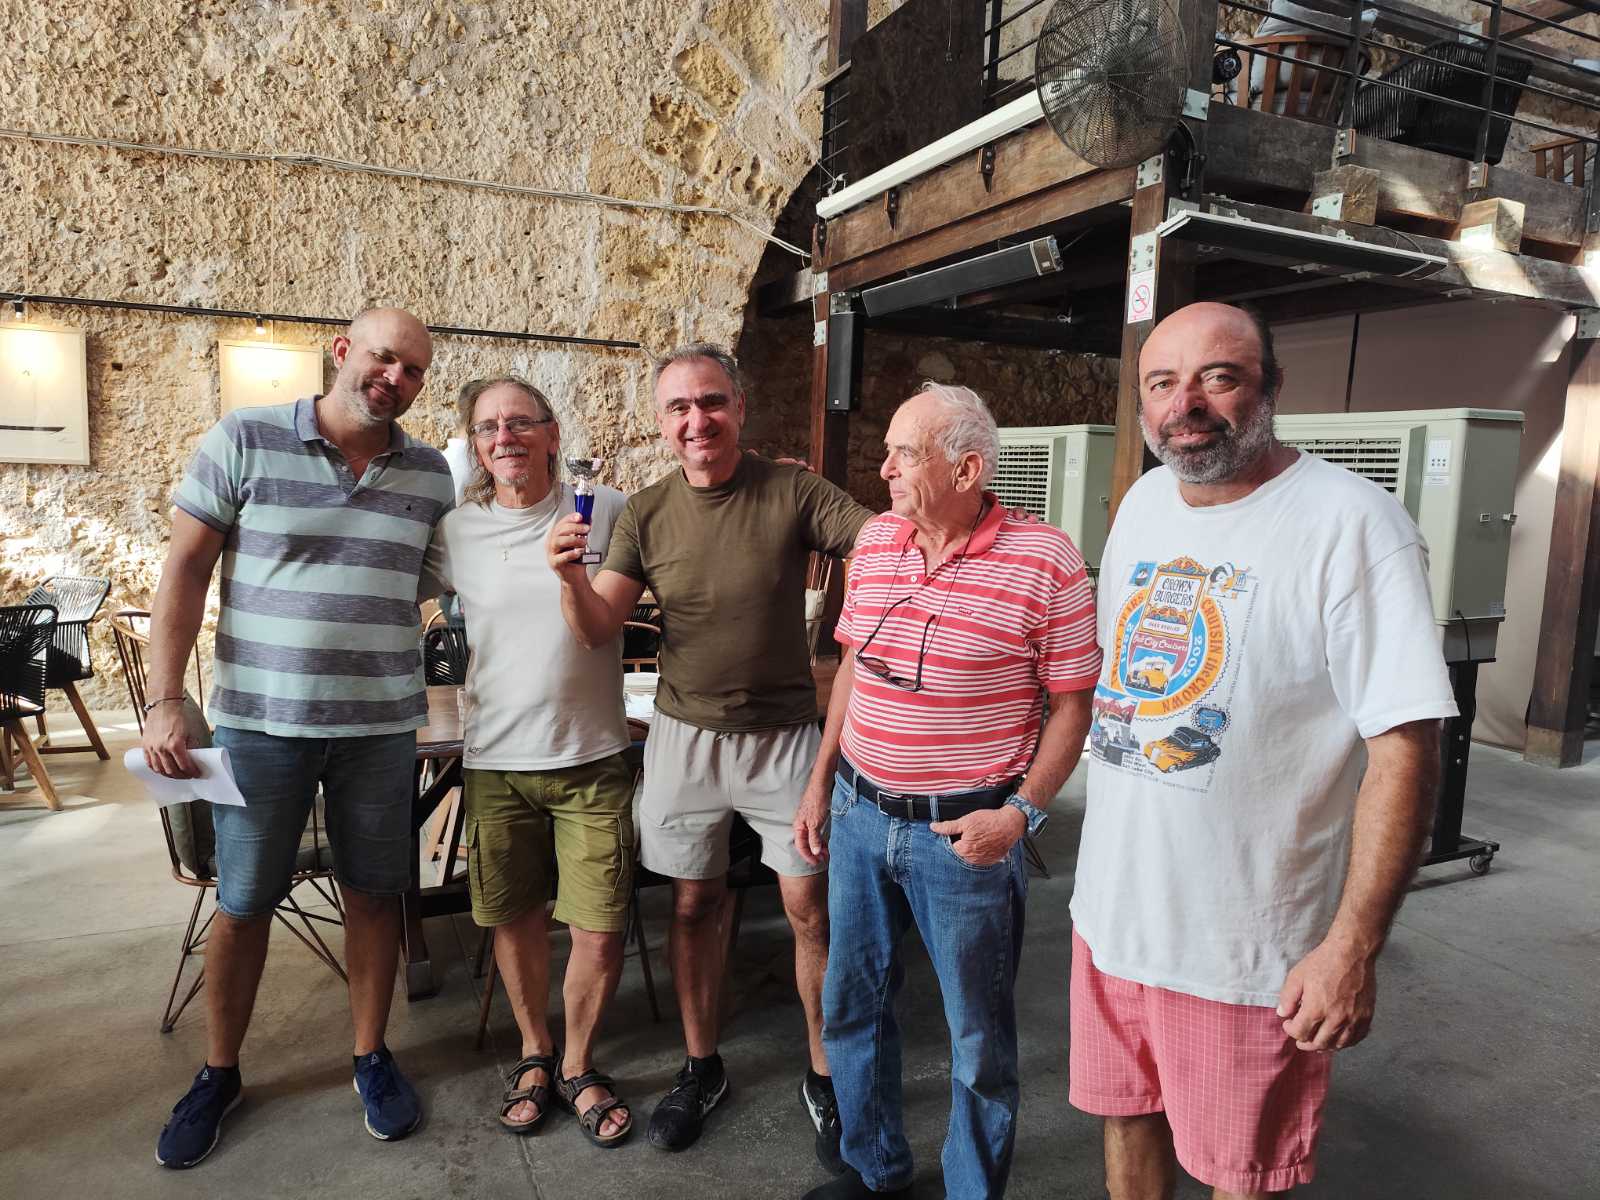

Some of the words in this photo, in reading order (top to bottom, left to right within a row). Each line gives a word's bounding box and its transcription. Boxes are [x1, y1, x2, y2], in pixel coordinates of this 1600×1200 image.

[1161, 577, 1195, 592] CROWN
[1153, 590, 1194, 606] BURGERS
[1161, 677, 1210, 713] CROWN
